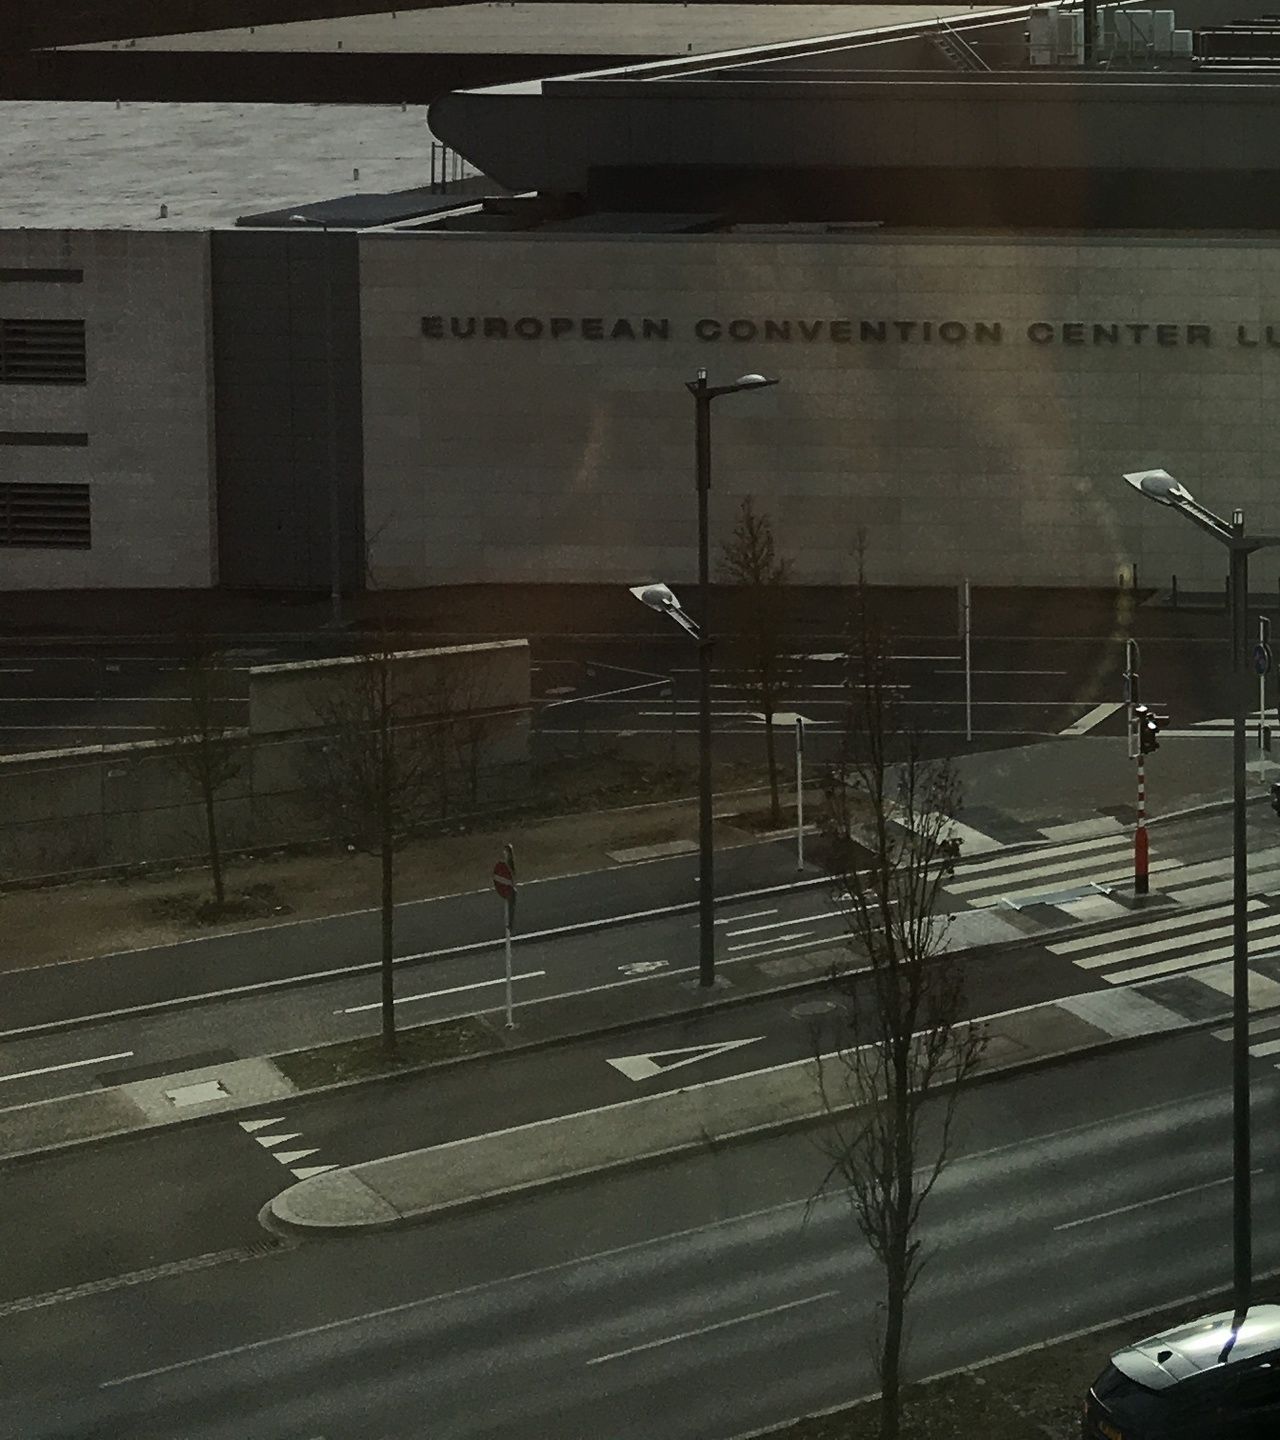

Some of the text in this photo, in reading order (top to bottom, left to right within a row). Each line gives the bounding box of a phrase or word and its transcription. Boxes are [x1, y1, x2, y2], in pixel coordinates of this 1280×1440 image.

[421, 316, 670, 339] EUROPEAN
[695, 318, 1003, 343] CONVENTION
[1028, 322, 1211, 346] CENTER
